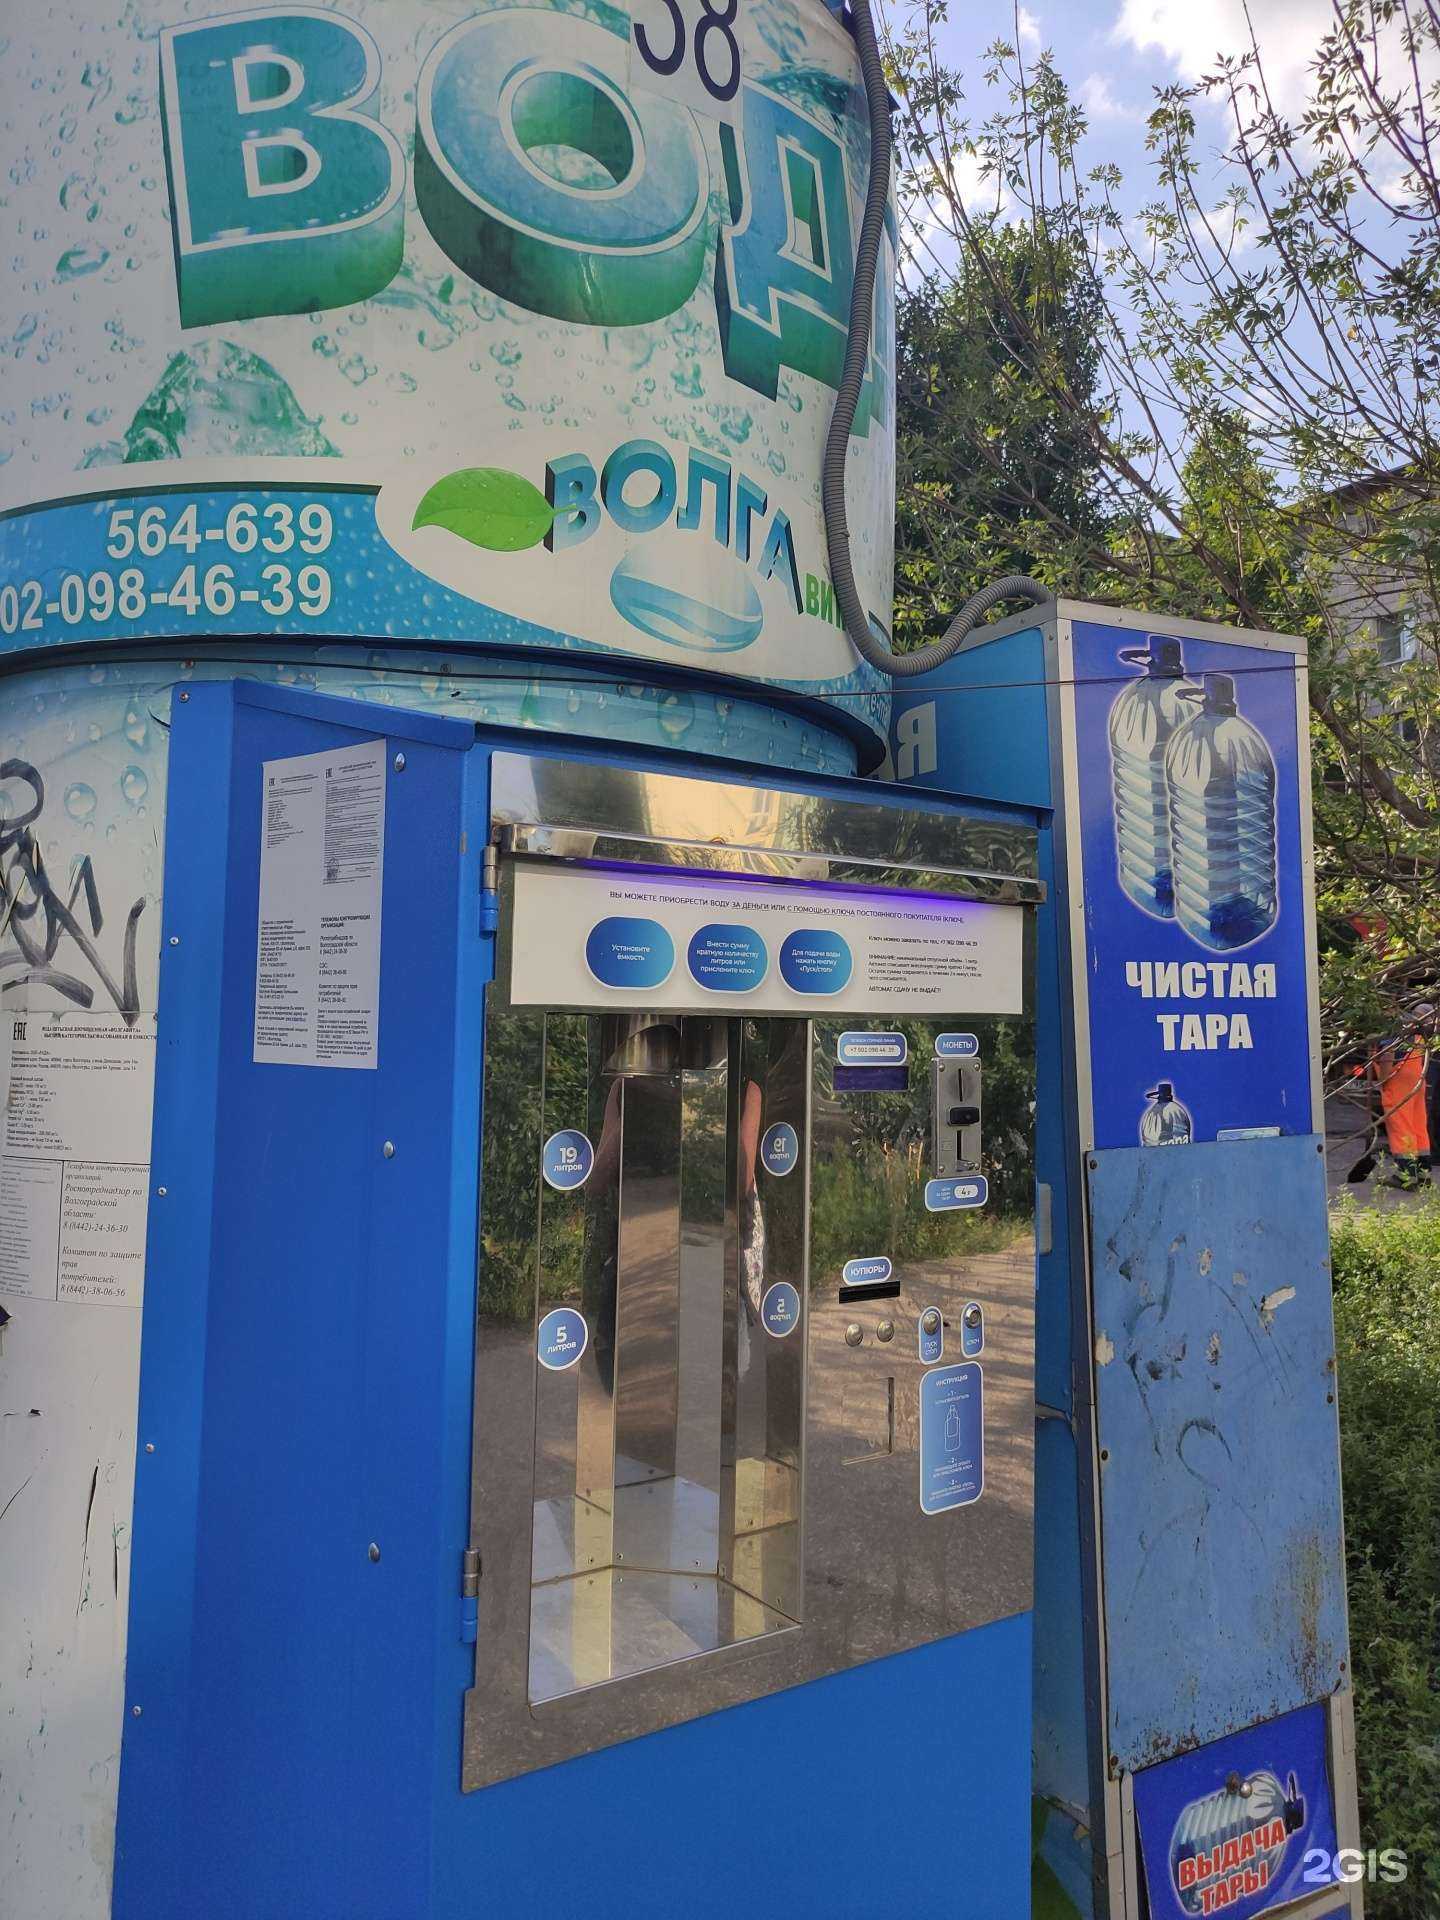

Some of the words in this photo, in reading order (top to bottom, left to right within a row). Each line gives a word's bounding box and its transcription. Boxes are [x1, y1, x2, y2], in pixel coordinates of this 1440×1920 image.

[160, 5, 893, 436] ВОД
[107, 503, 333, 559] 564-639
[543, 439, 803, 615] ВОЛГА
[0, 564, 331, 634] 02-098-46-39
[624, 892, 657, 902] МОЖЕТЕ
[659, 895, 708, 906] ПРИОБРЕСТИ
[710, 899, 730, 908] ВОДУ
[742, 902, 769, 911] ДЕНЬГИ
[770, 903, 786, 911] ИЛИ
[831, 908, 855, 917] КЛЮЧА
[856, 909, 902, 919] ПОСТОЯННОГО
[611, 943, 650, 953] Установите
[706, 940, 729, 949] Внести
[730, 942, 750, 951] сумму
[1126, 962, 1276, 998] ЧИСТАЯ
[1156, 1014, 1253, 1050] ТАРА
[943, 1041, 973, 1049] МОНЕТЫ
[559, 1147, 578, 1164] 19
[553, 1163, 583, 1173] литров
[850, 1265, 886, 1276] КУПЮРЫ
[556, 1326, 568, 1343] 5
[547, 1341, 577, 1354] литров
[935, 1374, 968, 1387] ИНСТРУКЦИЯ
[1179, 1817, 1286, 1891] ВЫДАЧА
[1200, 1860, 1268, 1916] ТАРЫ
